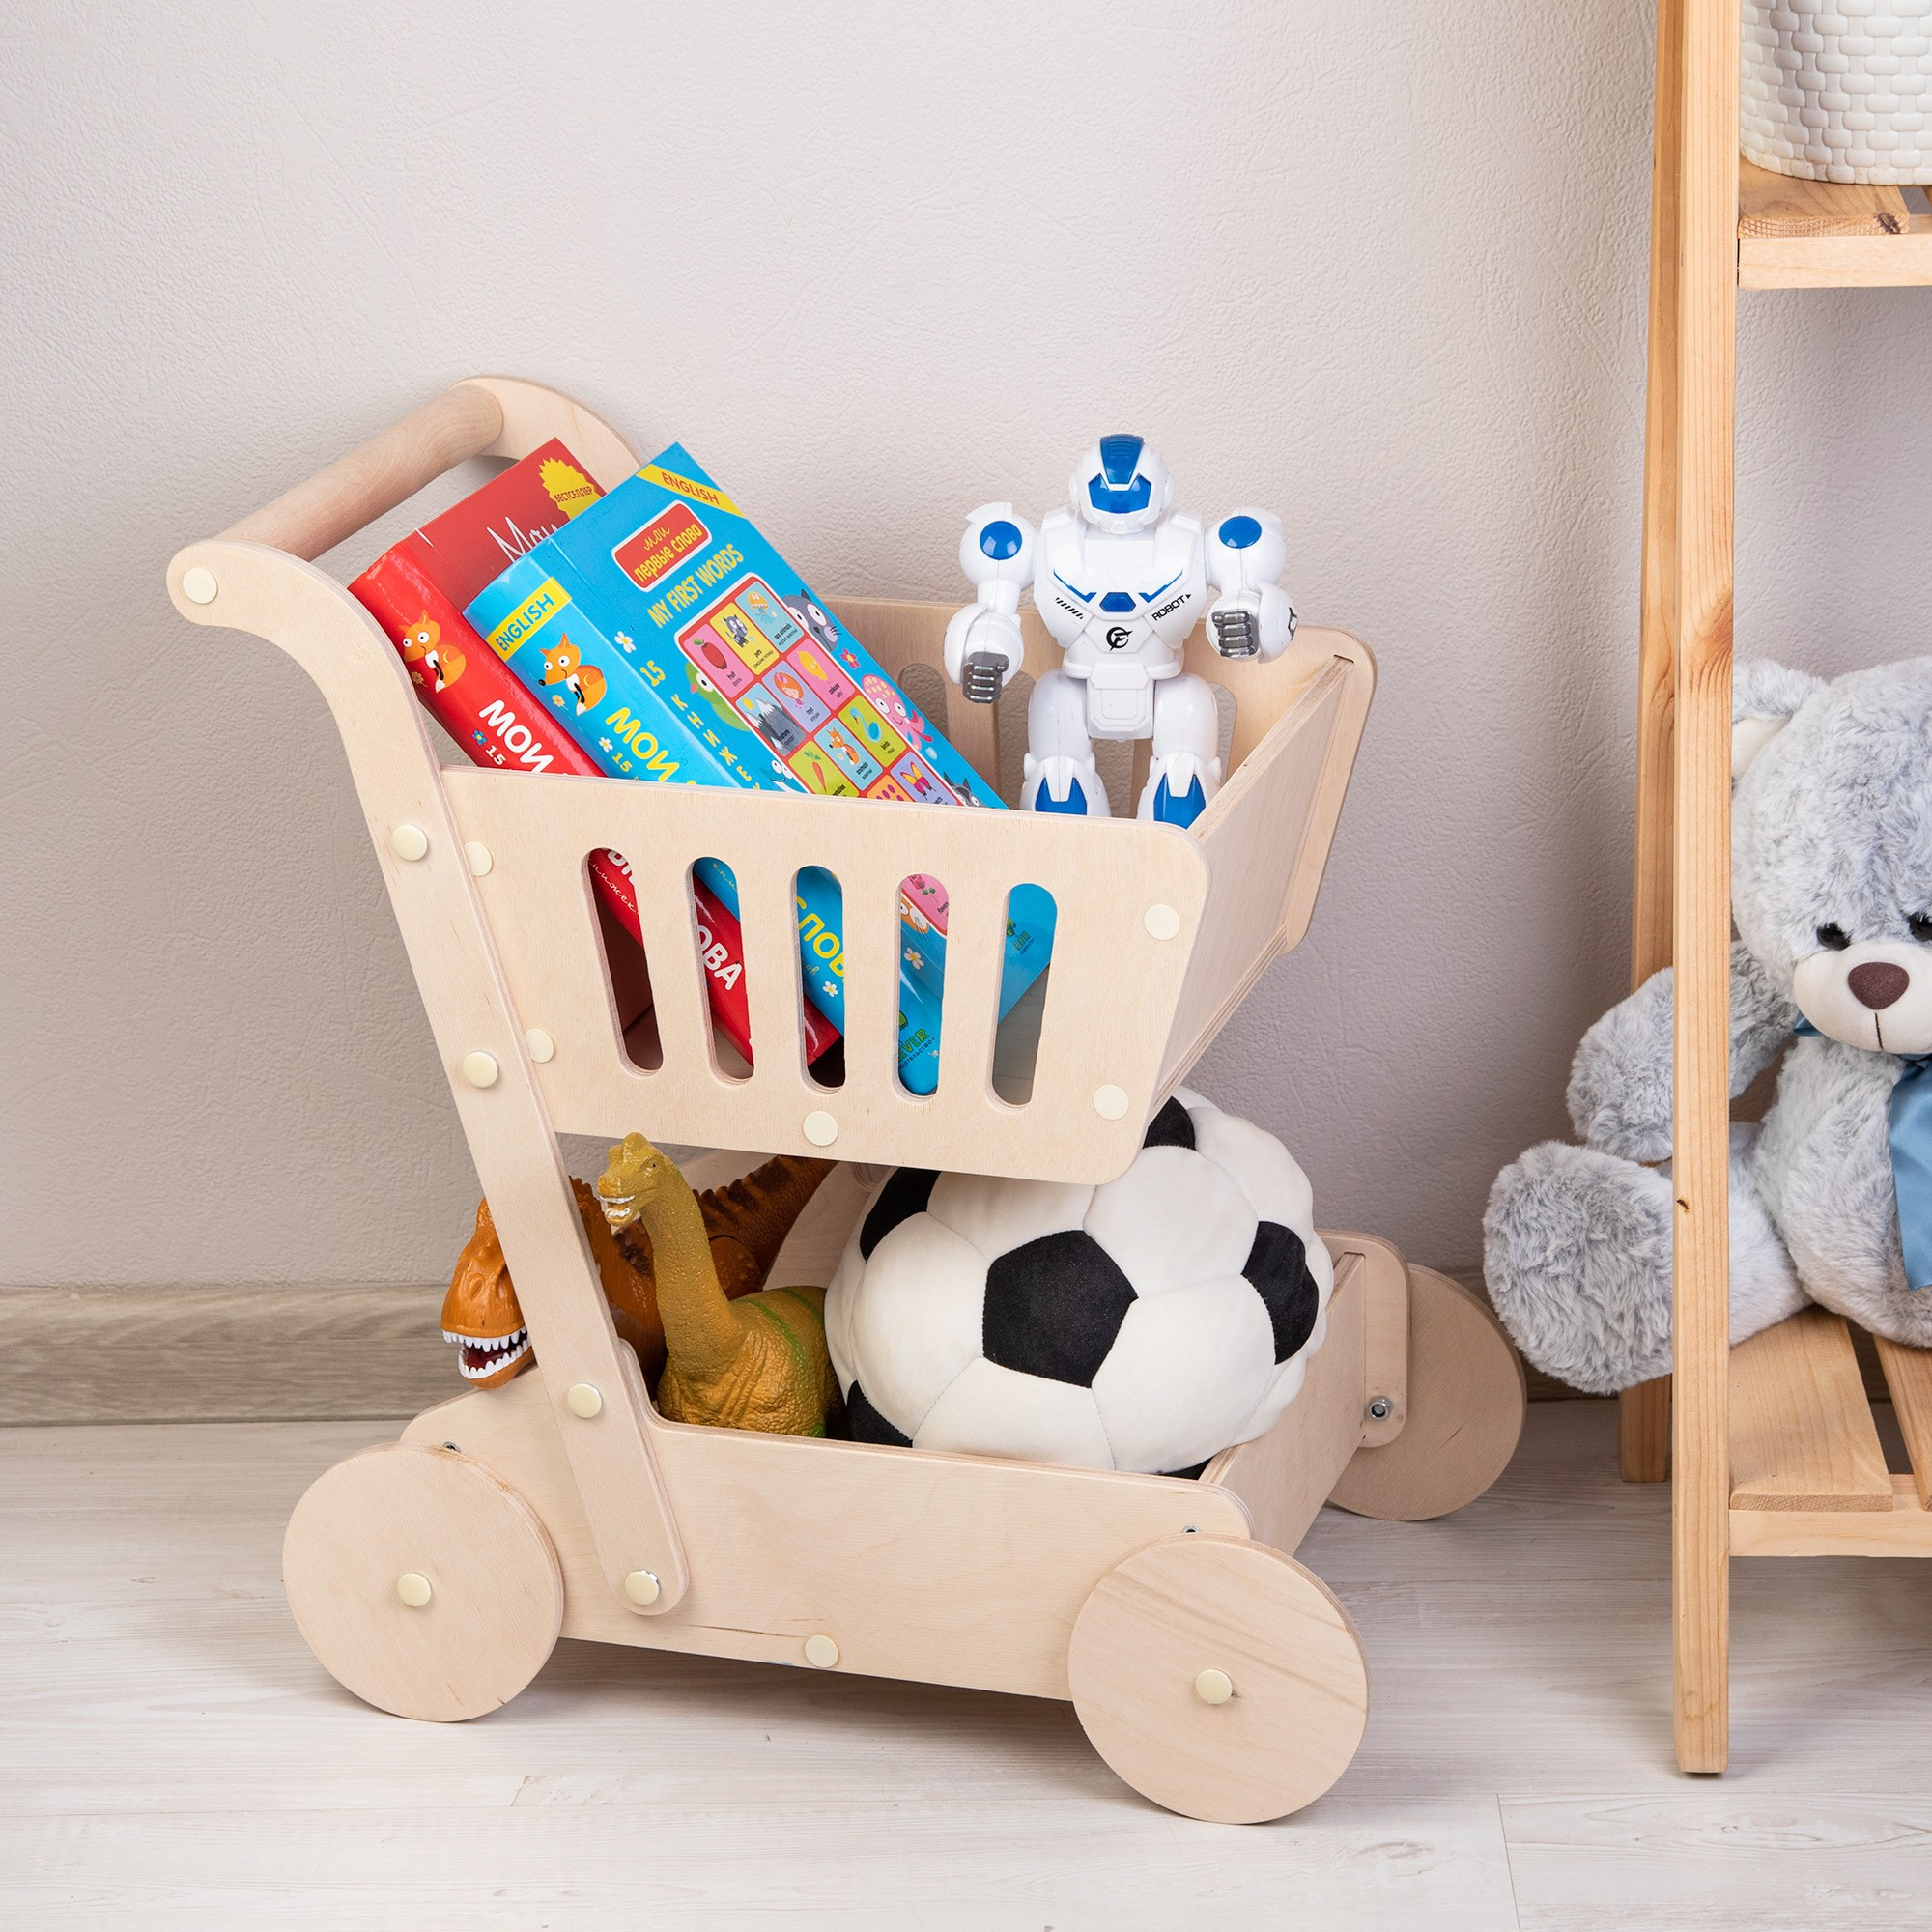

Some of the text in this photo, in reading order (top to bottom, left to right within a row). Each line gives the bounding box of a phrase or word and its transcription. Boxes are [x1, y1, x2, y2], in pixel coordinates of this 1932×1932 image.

[661, 471, 720, 505] ENGLISH
[634, 523, 703, 582] первые слова
[644, 527, 670, 551] мои
[647, 543, 744, 628] MY FIRST WORDS
[495, 593, 555, 651] ENGLISH
[1151, 595, 1184, 621] ROBOT
[640, 660, 666, 687] 15
[479, 700, 554, 772] МОИ
[485, 745, 506, 766] 15
[605, 707, 680, 781] МОИ
[611, 753, 634, 772] 15
[589, 859, 637, 913] нижек
